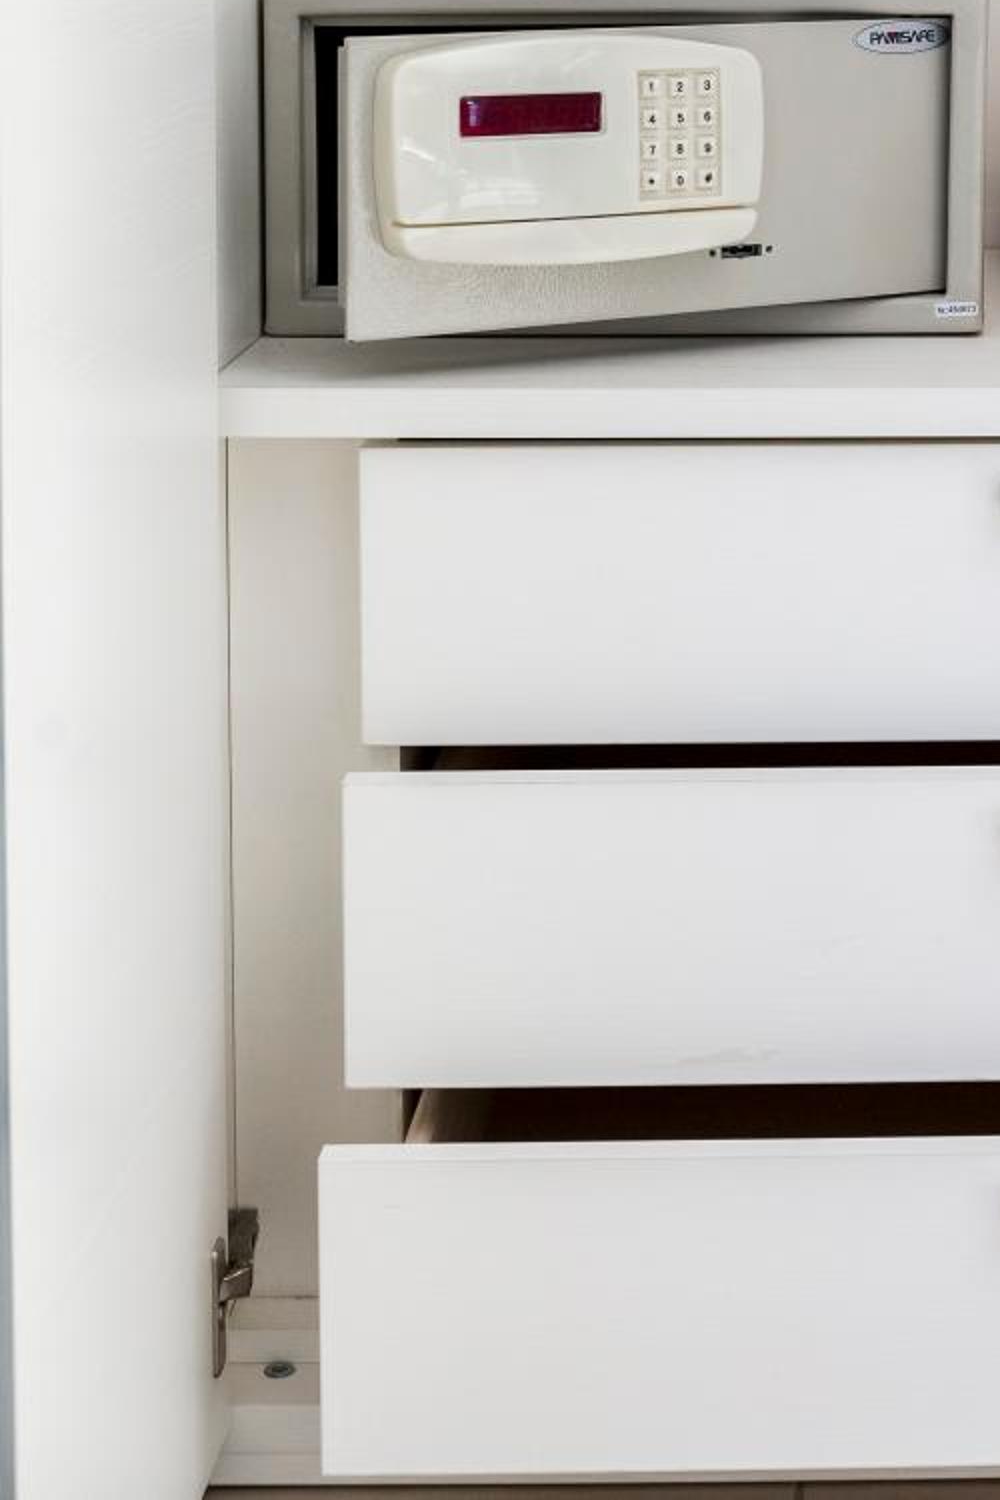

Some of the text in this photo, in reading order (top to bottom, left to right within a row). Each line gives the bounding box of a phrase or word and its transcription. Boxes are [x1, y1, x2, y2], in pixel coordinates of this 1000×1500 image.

[676, 80, 684, 93] 2
[703, 79, 712, 92] 3
[676, 112, 685, 124] 5
[703, 110, 712, 123] 6
[676, 142, 685, 156] 8
[703, 142, 712, 154] 9
[676, 174, 685, 187] 0
